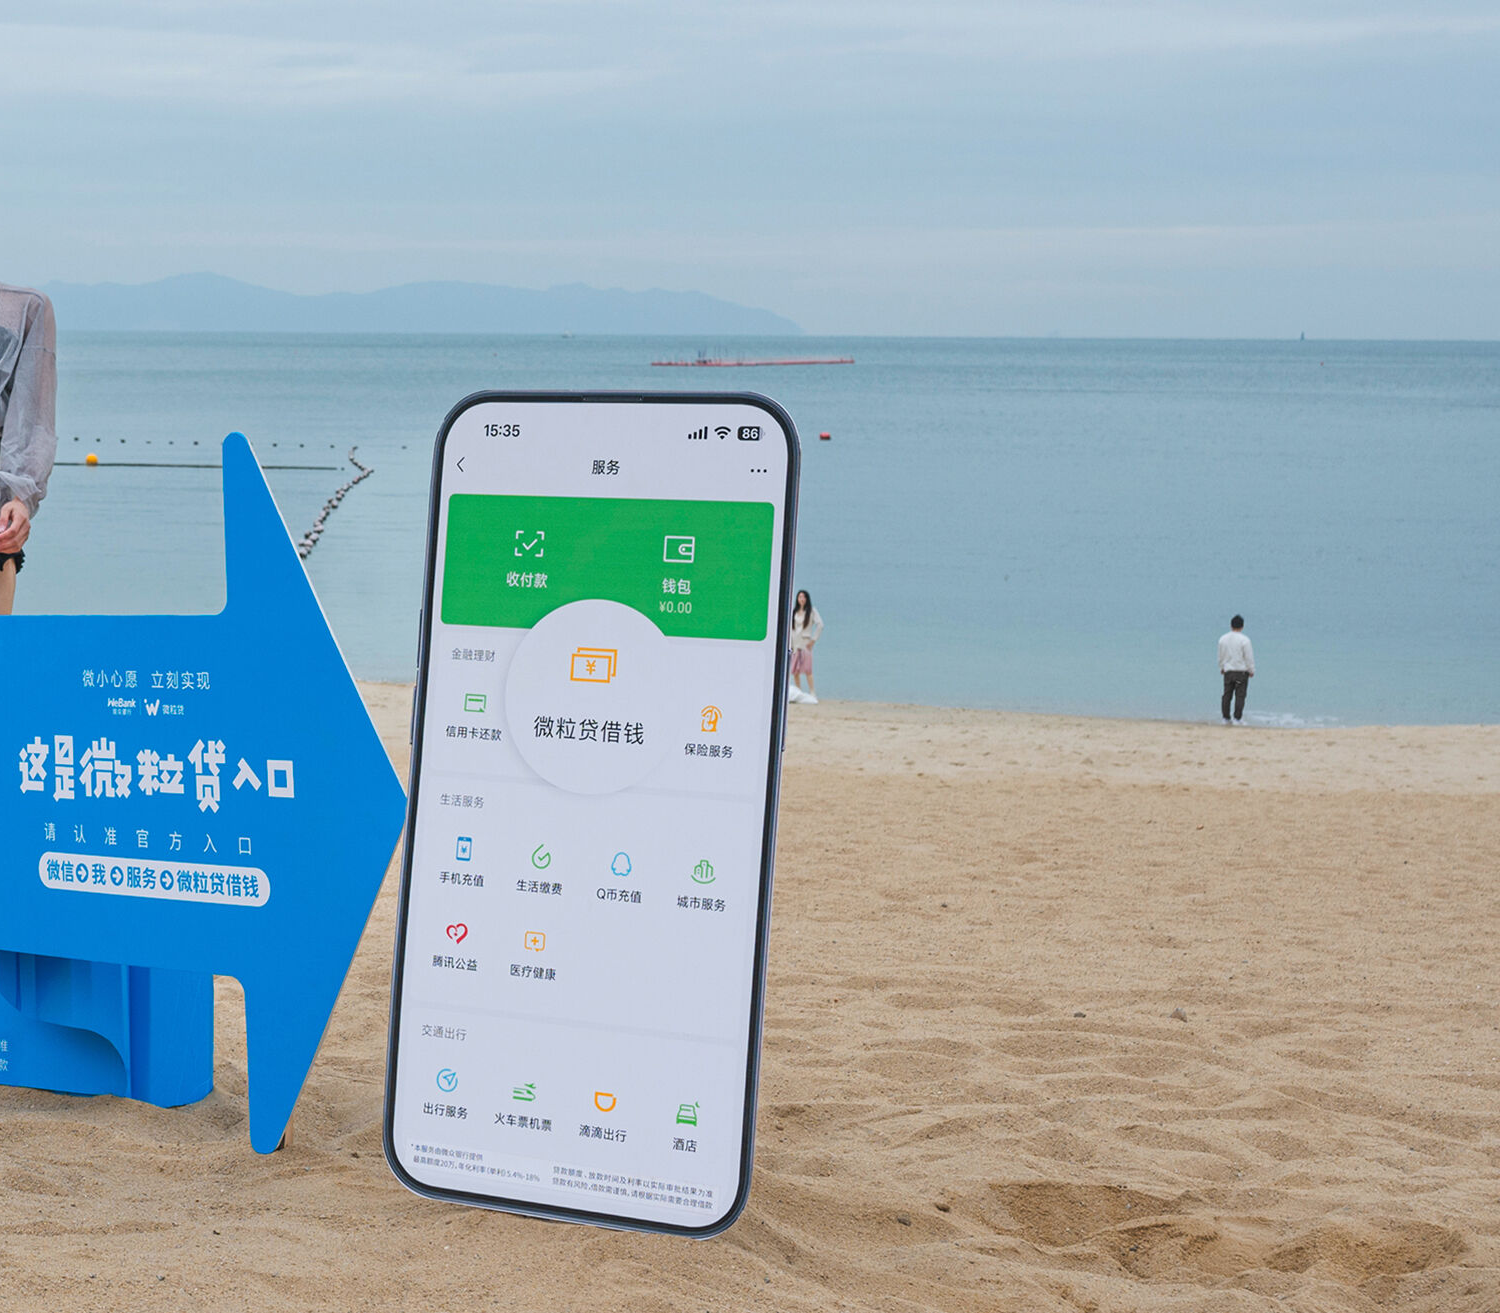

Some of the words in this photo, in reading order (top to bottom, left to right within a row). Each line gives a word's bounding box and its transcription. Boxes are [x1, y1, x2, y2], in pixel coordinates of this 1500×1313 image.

[484, 425, 520, 438] 15:35
[742, 428, 759, 440] 86
[591, 460, 620, 476] 服务
[506, 572, 548, 589] 收付款
[662, 578, 691, 595] 钱包
[659, 602, 692, 614] ¥0.00
[451, 648, 495, 663] 金融理财
[82, 669, 138, 689] 微小心愿
[151, 670, 211, 690] 立刻实现
[107, 698, 136, 708] WeBank
[162, 704, 184, 715] 微粒贷
[445, 725, 502, 742] 信用卡还款
[533, 715, 645, 745] 微粒贷借钱
[684, 742, 734, 759] 保险服务
[19, 735, 295, 814] 这是微粒贷入口
[440, 793, 484, 809] 生活服务
[46, 859, 74, 883] 微信
[91, 863, 106, 886] 我
[127, 866, 157, 890] 服务
[176, 869, 260, 898] 微粒贷借钱
[439, 871, 484, 888] 手机充值
[516, 879, 563, 896] 生活缴费
[596, 887, 642, 905] Q币充值
[676, 894, 726, 913] 城市服务
[432, 955, 478, 972] 腾讯公益
[510, 964, 556, 981] 医疗健康
[421, 1024, 467, 1041] 交通出行
[423, 1102, 468, 1120] 出行服务
[494, 1112, 552, 1132] 火车票机票
[579, 1124, 627, 1143] 滴滴出行
[672, 1137, 697, 1153] 酒店
